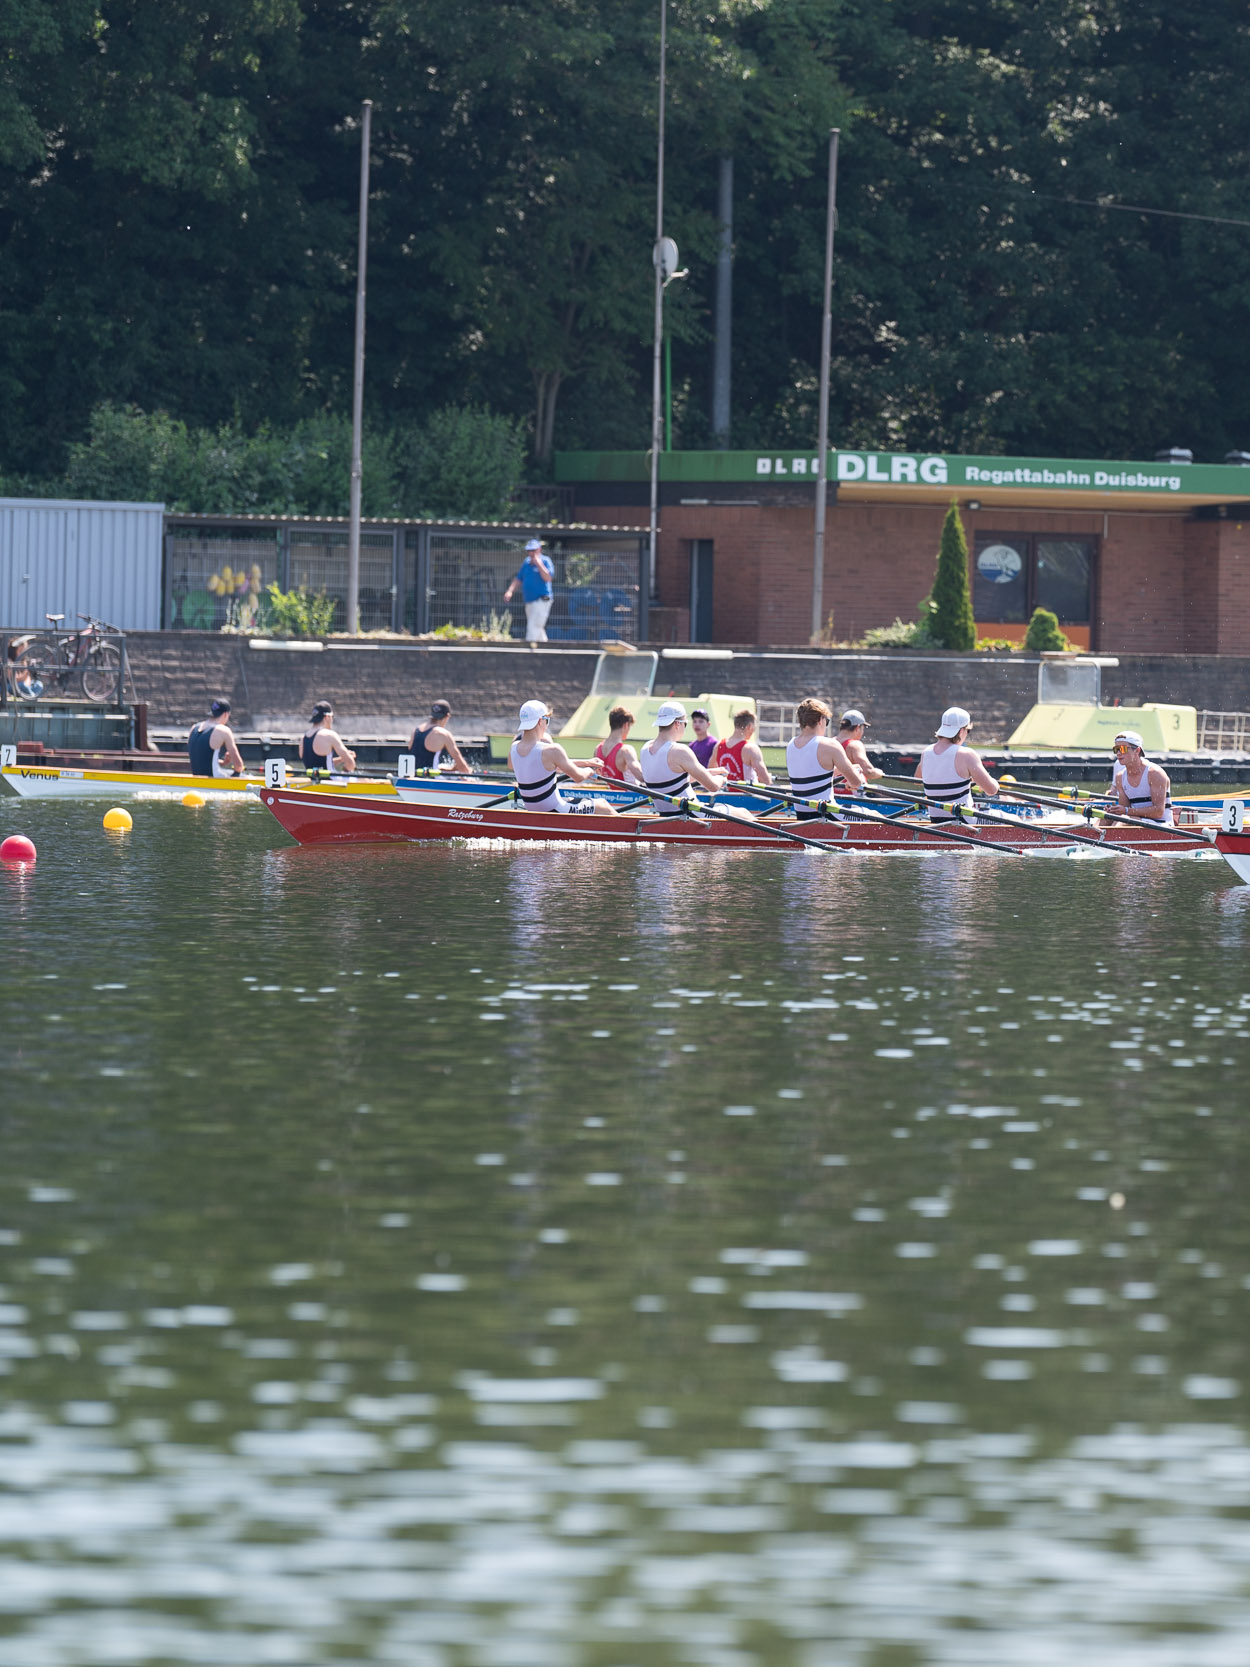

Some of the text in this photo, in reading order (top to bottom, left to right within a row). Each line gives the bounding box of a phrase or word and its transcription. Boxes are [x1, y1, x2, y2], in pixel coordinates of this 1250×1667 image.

[837, 454, 1181, 490] DLRG Regattabahn Duisburg
[5, 749, 11, 762] 7
[271, 763, 279, 782] 5
[404, 758, 409, 774] 1
[20, 769, 59, 781] Venus
[448, 809, 484, 821] Ratzeburg
[1229, 805, 1237, 827] 3
